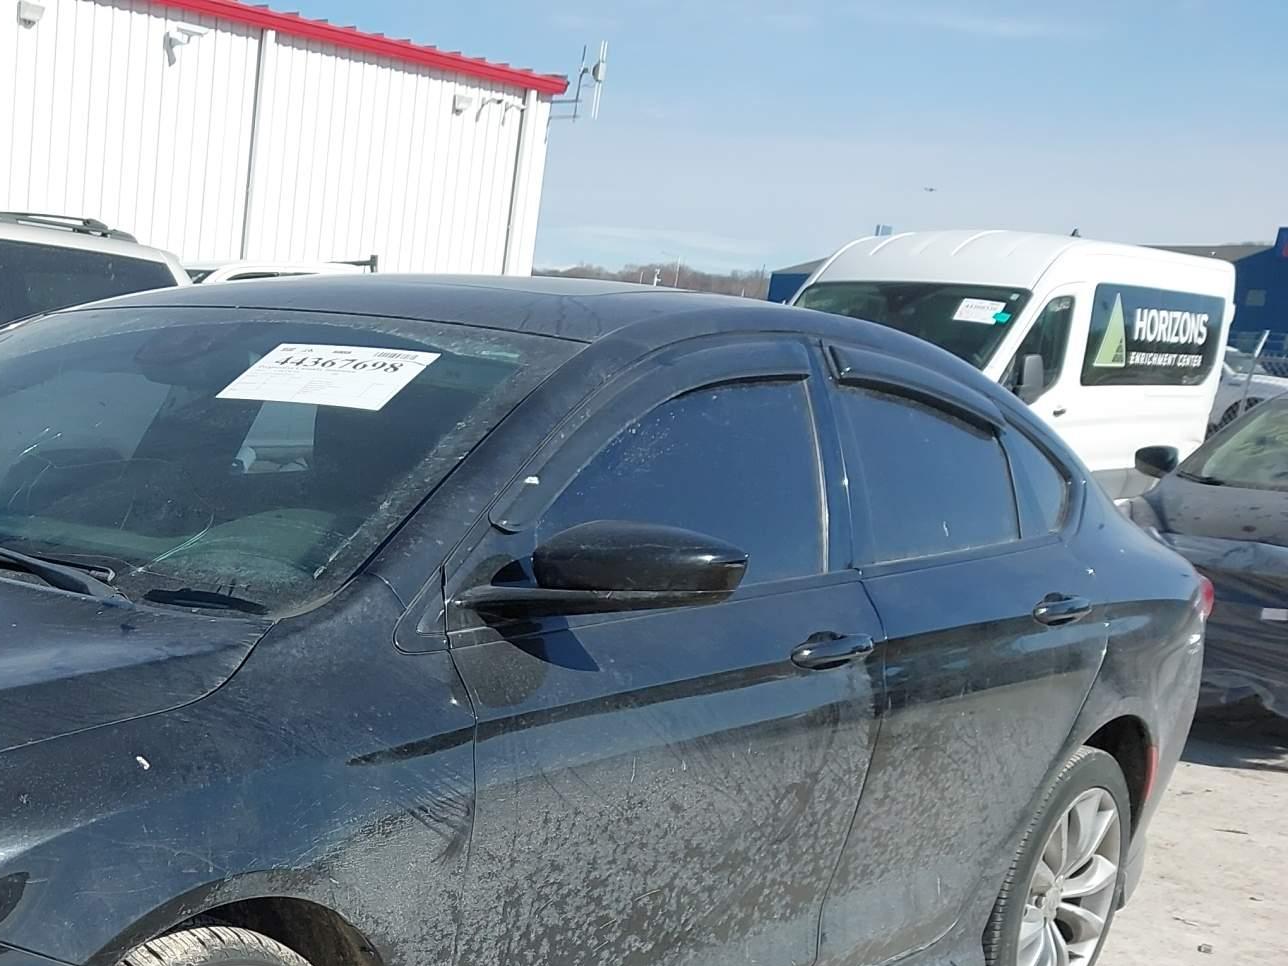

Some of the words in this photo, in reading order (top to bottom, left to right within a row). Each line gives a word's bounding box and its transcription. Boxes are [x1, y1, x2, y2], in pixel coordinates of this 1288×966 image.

[1133, 308, 1209, 345] HORIZONS
[274, 355, 404, 373] 44367698
[1129, 351, 1177, 367] ENRICHMENT
[1177, 353, 1203, 368] CENTER
